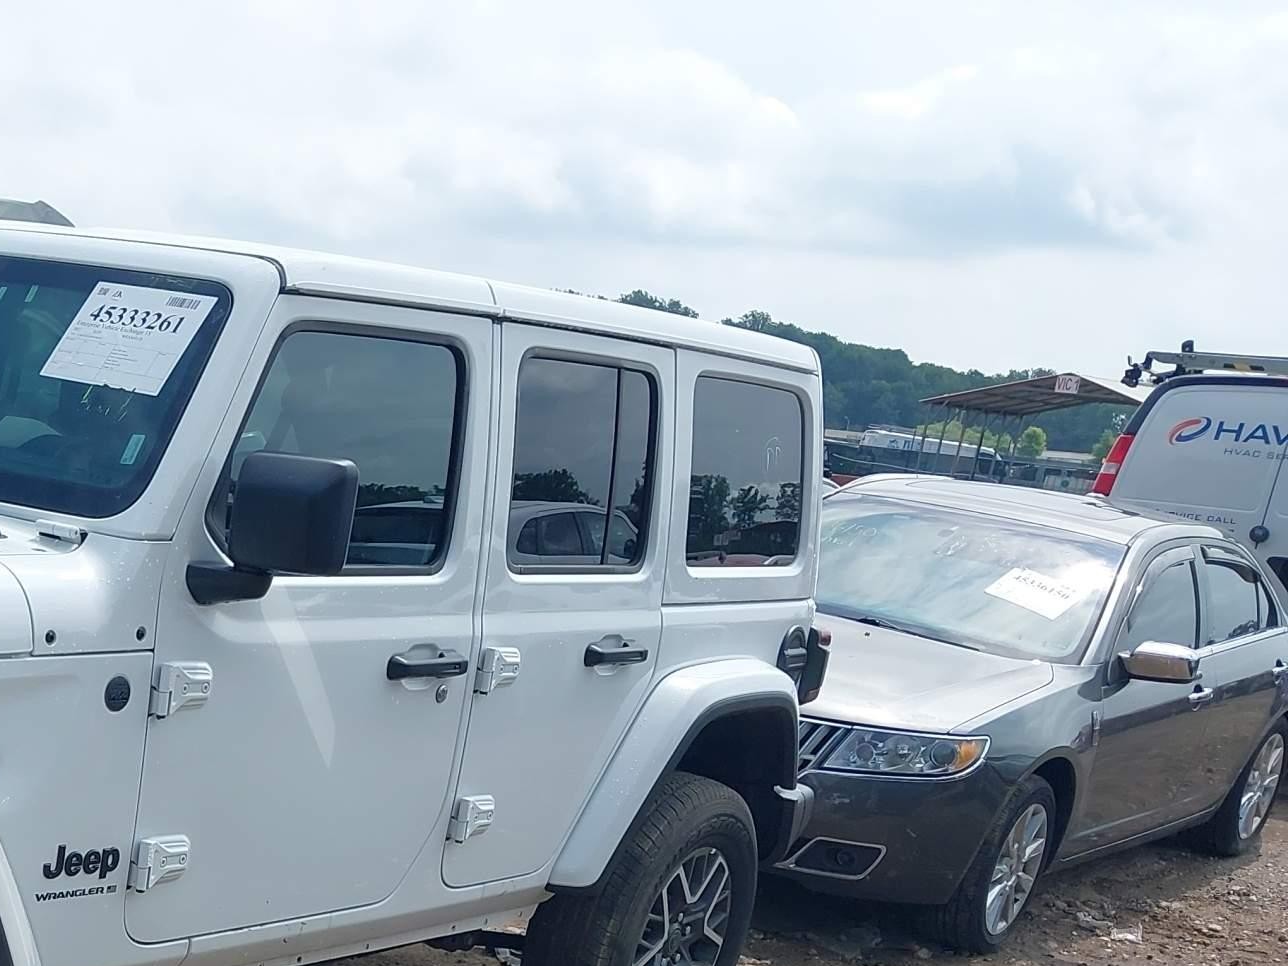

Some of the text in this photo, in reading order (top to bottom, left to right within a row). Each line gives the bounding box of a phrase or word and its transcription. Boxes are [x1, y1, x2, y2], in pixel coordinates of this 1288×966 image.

[90, 304, 186, 334] 45333261
[1223, 447, 1262, 459] HVAC
[1207, 515, 1237, 525] CALL
[42, 844, 120, 880] Jeep
[34, 886, 106, 902] WRANGLER
